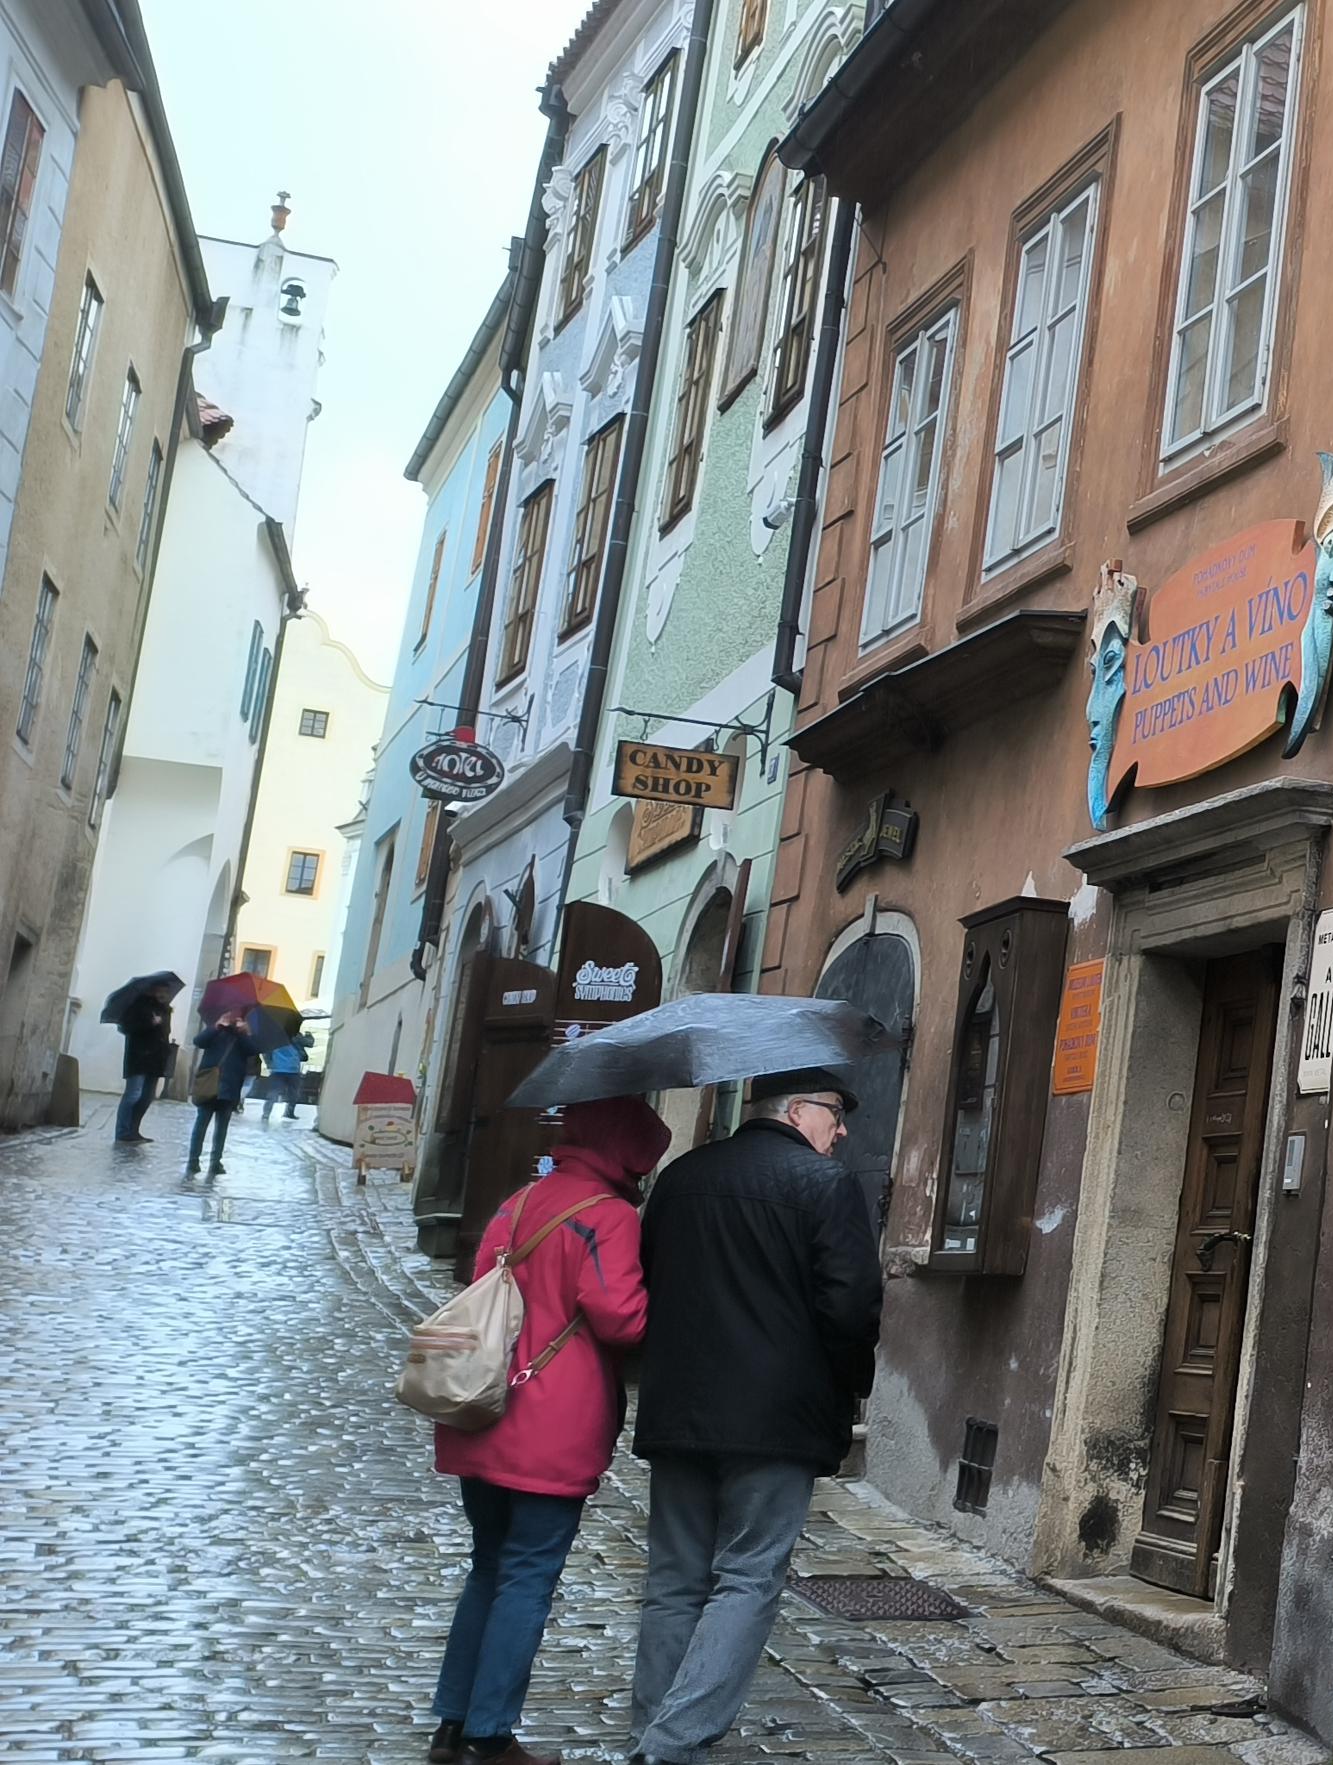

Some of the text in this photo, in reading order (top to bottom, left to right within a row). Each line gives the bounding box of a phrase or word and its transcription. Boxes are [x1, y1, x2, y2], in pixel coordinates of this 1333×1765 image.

[1132, 571, 1309, 696] LOUTKY A VÍNO
[1132, 642, 1294, 744] PUPPETS AND WINE
[629, 749, 726, 777] CANDY
[632, 774, 711, 799] SHOP
